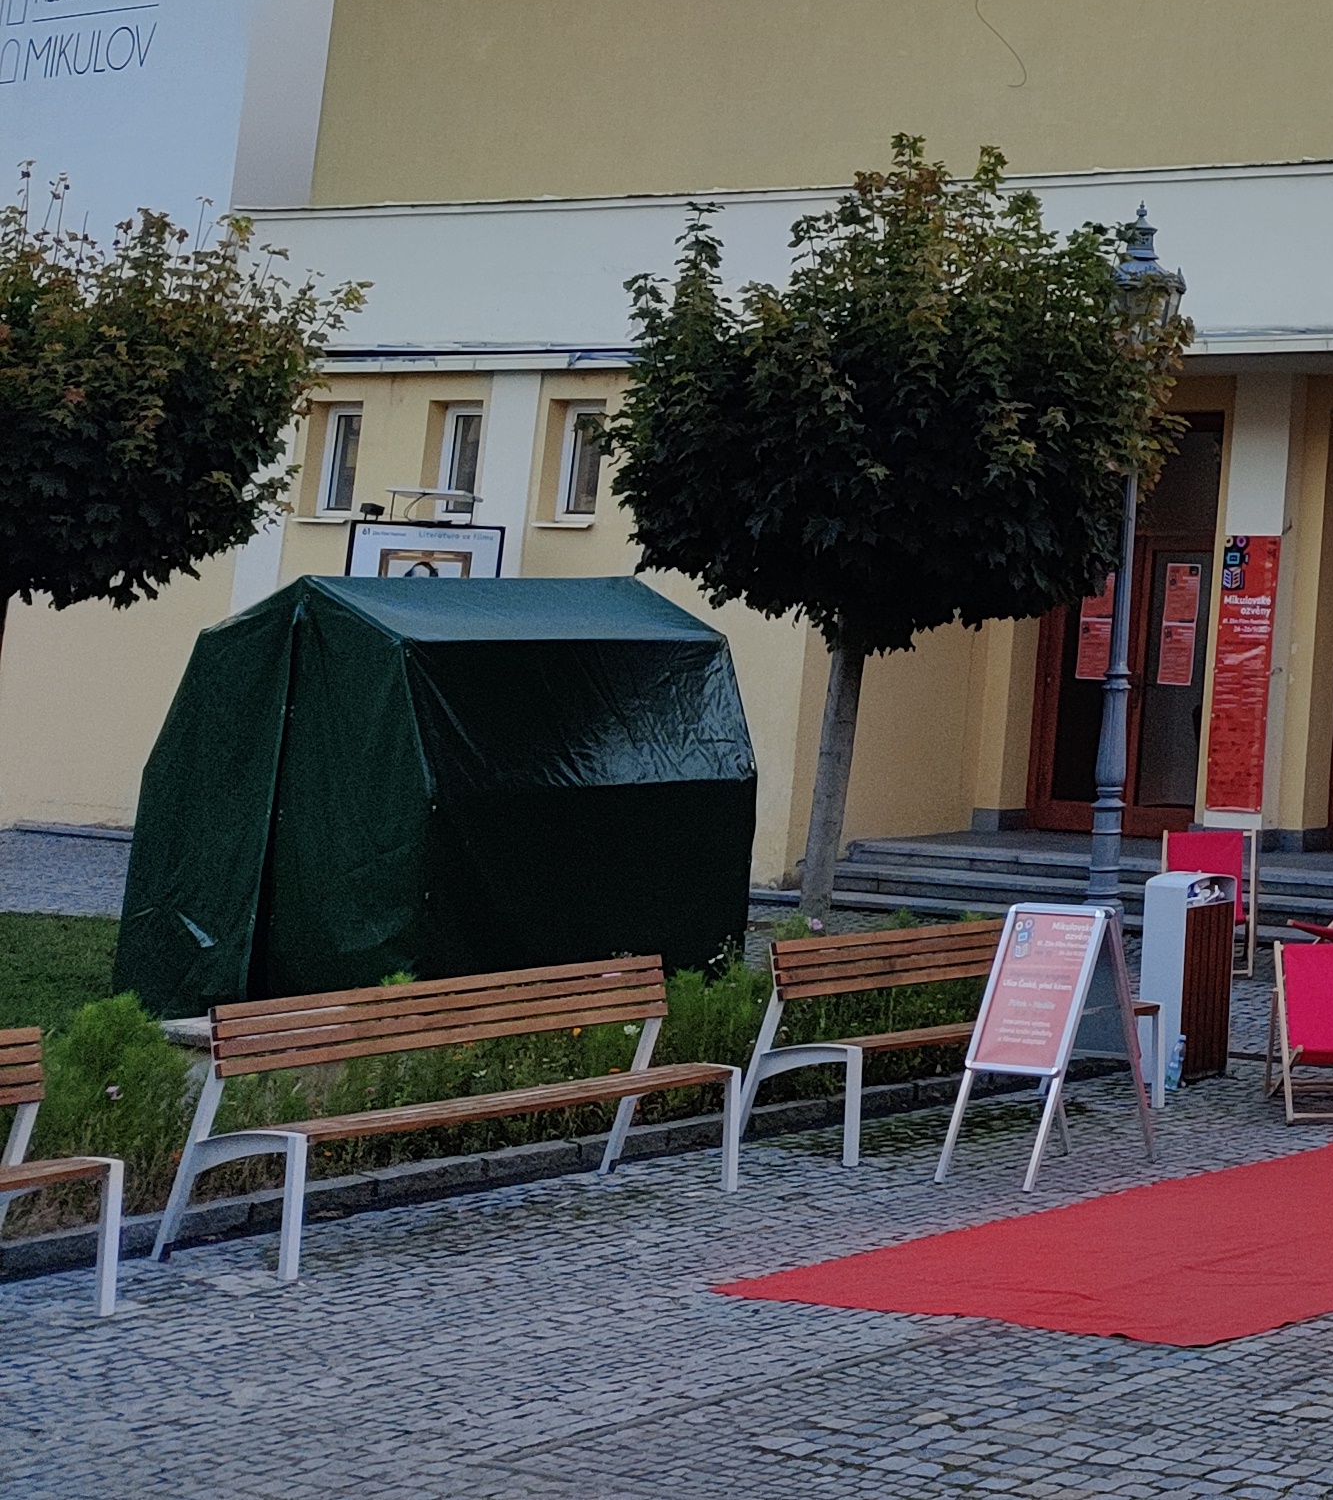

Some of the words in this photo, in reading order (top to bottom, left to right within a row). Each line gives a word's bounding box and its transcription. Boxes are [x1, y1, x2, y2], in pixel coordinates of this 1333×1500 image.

[24, 22, 157, 81] MIKULOV
[418, 531, 460, 540] Literatura
[1224, 595, 1271, 605] Mikulovské
[1240, 606, 1271, 617] ozvěny
